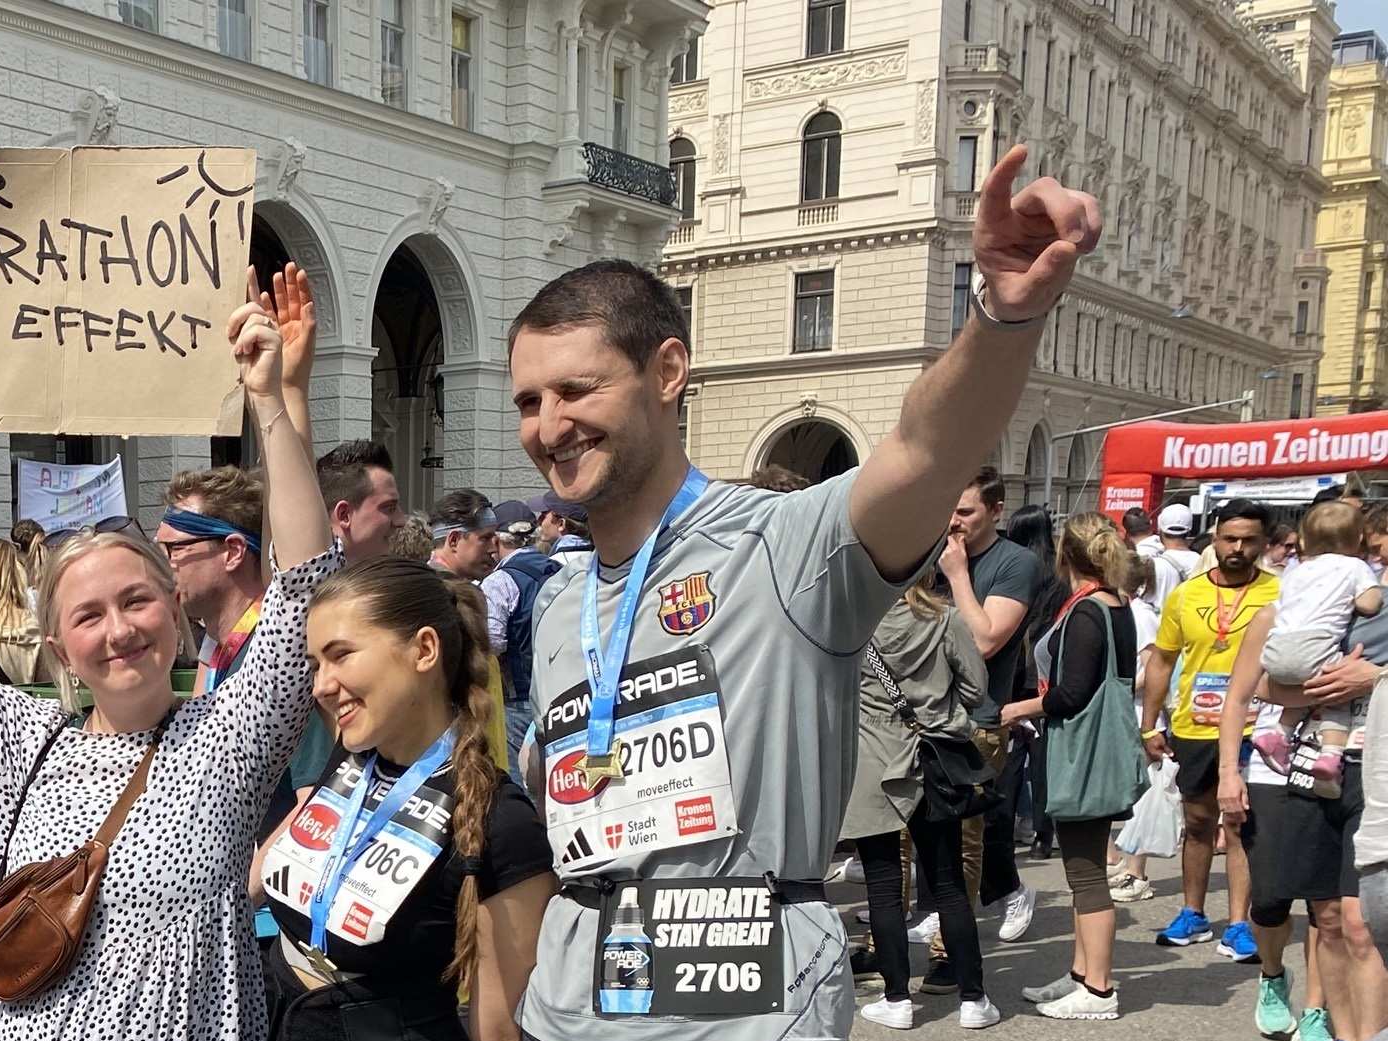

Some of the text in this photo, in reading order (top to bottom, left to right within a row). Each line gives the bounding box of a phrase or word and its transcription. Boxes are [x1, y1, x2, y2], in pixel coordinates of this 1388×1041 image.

[11, 303, 212, 358] EFFEKT
[1164, 428, 1388, 469] Kronen Zeitung
[1105, 486, 1144, 499] Kronen
[621, 721, 715, 777] 2706D
[636, 776, 694, 799] moveeffect
[676, 803, 712, 817] Kronen
[627, 816, 657, 832] Stadt
[678, 815, 714, 829] Zeitung
[628, 831, 658, 846] Wien
[652, 887, 771, 920] HYDRATE
[654, 921, 774, 948] STAY GREAT
[603, 950, 643, 960] POWER
[616, 959, 644, 969] ADE
[675, 961, 762, 993] 2706
